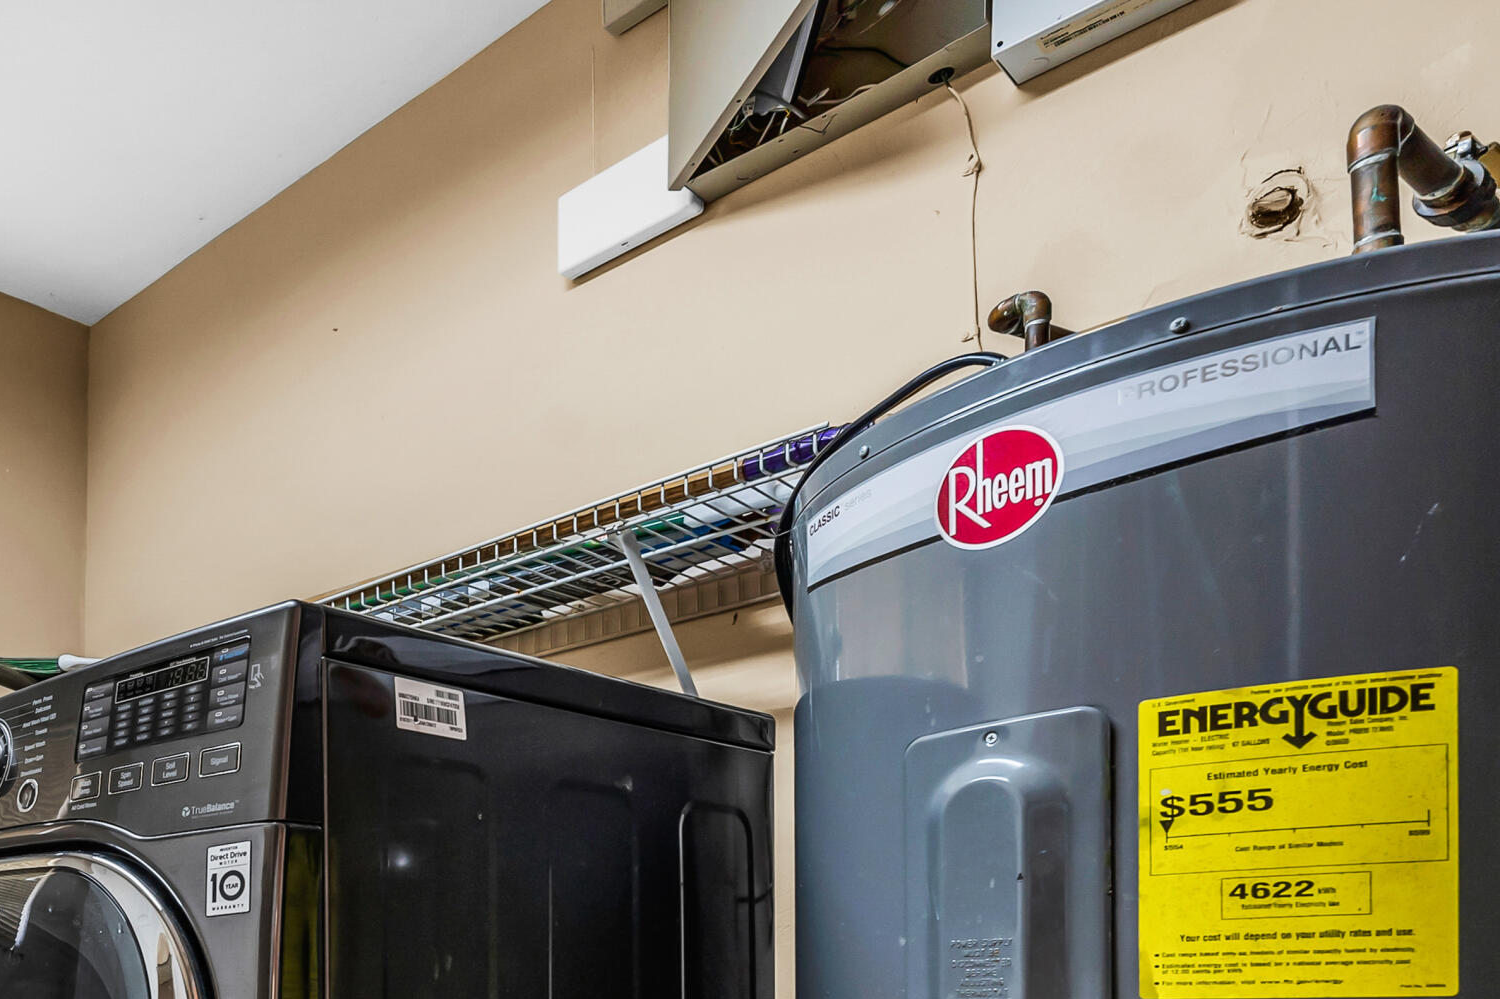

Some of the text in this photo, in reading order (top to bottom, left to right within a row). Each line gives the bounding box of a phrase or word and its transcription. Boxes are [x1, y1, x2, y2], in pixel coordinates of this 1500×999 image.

[1117, 333, 1362, 405] PROFESSIONAL
[949, 438, 1056, 537] Rheem
[809, 505, 840, 536] CLASSIC
[1158, 683, 1435, 742] ENERGYGUIDE
[166, 762, 176, 770] Soil
[211, 755, 228, 766] Signal
[121, 771, 131, 779] Spin
[163, 770, 178, 779] Level
[1207, 760, 1368, 781] Estimated Yearly Energy Cost
[118, 778, 134, 788] Speed
[191, 801, 235, 815] TrueBalance
[1160, 788, 1274, 820] $555
[210, 851, 247, 862] Direct Drive
[210, 870, 246, 903] 10
[1229, 880, 1314, 900] 4622
[1180, 934, 1200, 942] Your
[1203, 934, 1221, 942] cost
[1224, 932, 1240, 941] will
[1244, 931, 1277, 942] depend
[1281, 932, 1292, 940] on
[1296, 932, 1315, 940] your
[1319, 929, 1346, 939] utility
[1350, 929, 1371, 937] rates
[1375, 928, 1393, 936] and
